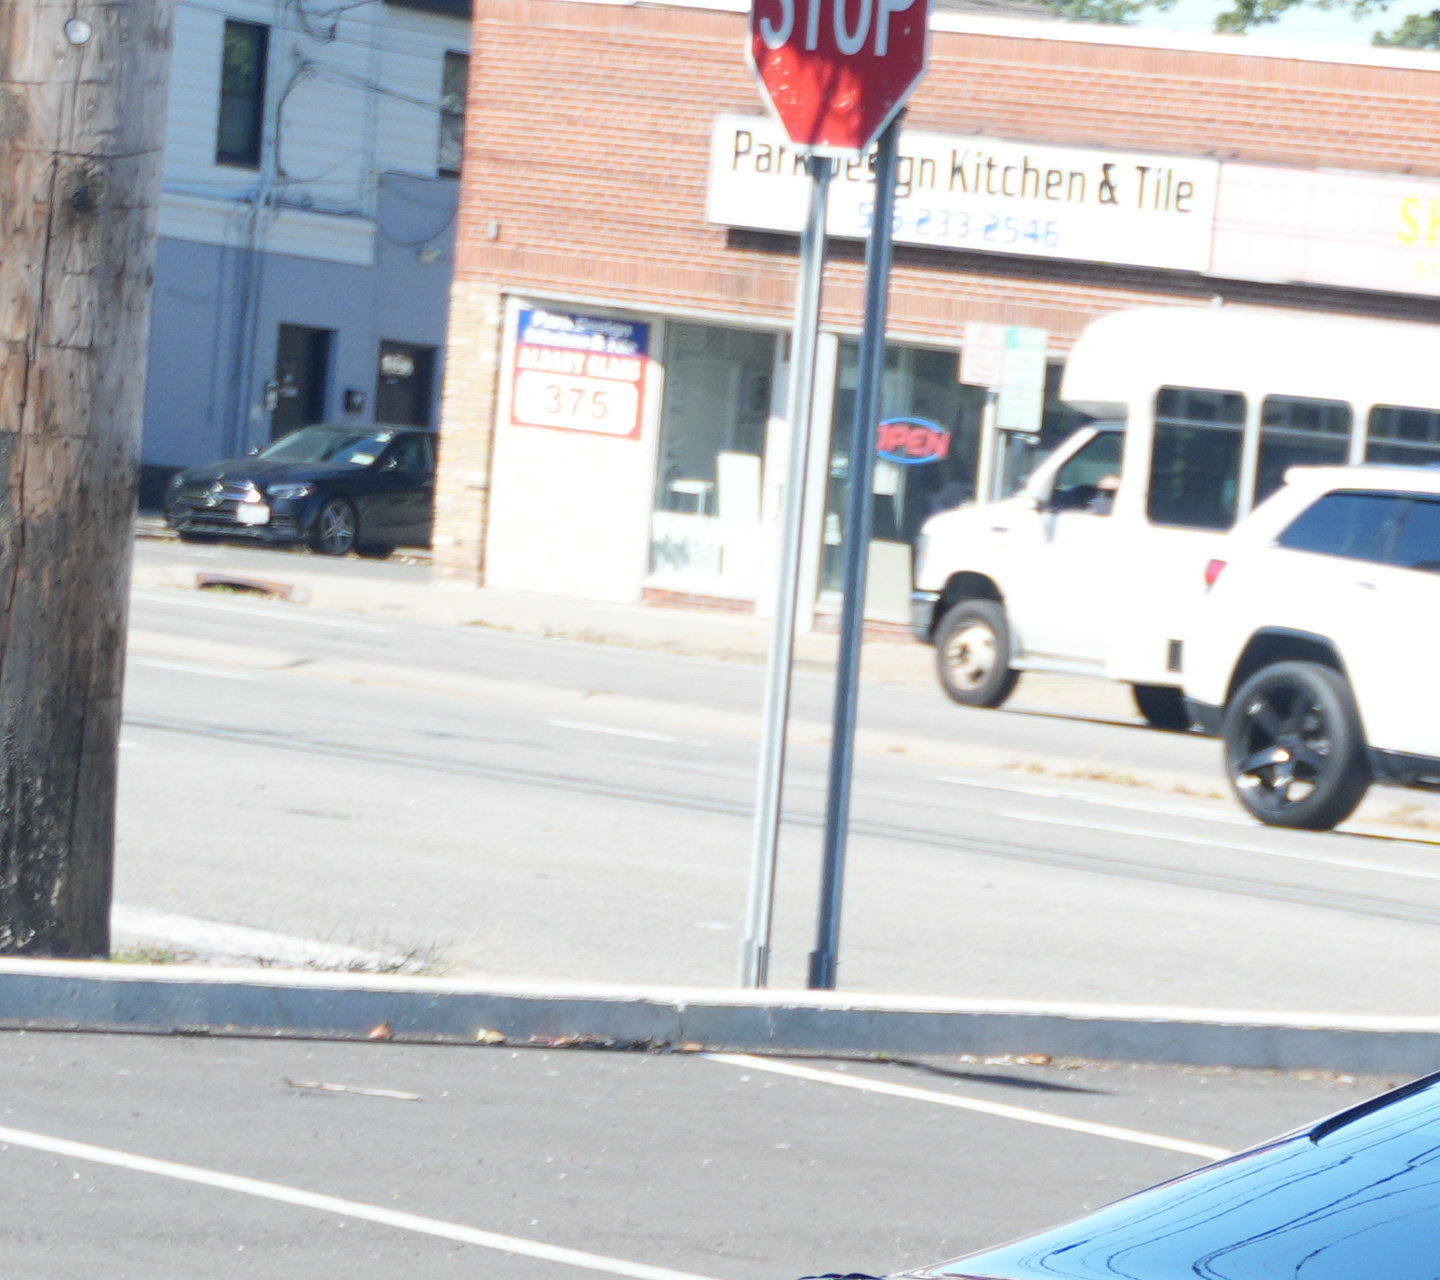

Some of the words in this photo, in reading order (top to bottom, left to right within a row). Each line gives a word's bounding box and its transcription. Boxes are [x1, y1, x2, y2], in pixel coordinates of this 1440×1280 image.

[828, 142, 938, 199] esgn
[948, 148, 1087, 202] Kitchen
[1098, 161, 1120, 206] &
[1134, 165, 1195, 214] Tile
[856, 201, 1061, 249] 56-233-2546
[545, 384, 608, 420] 375
